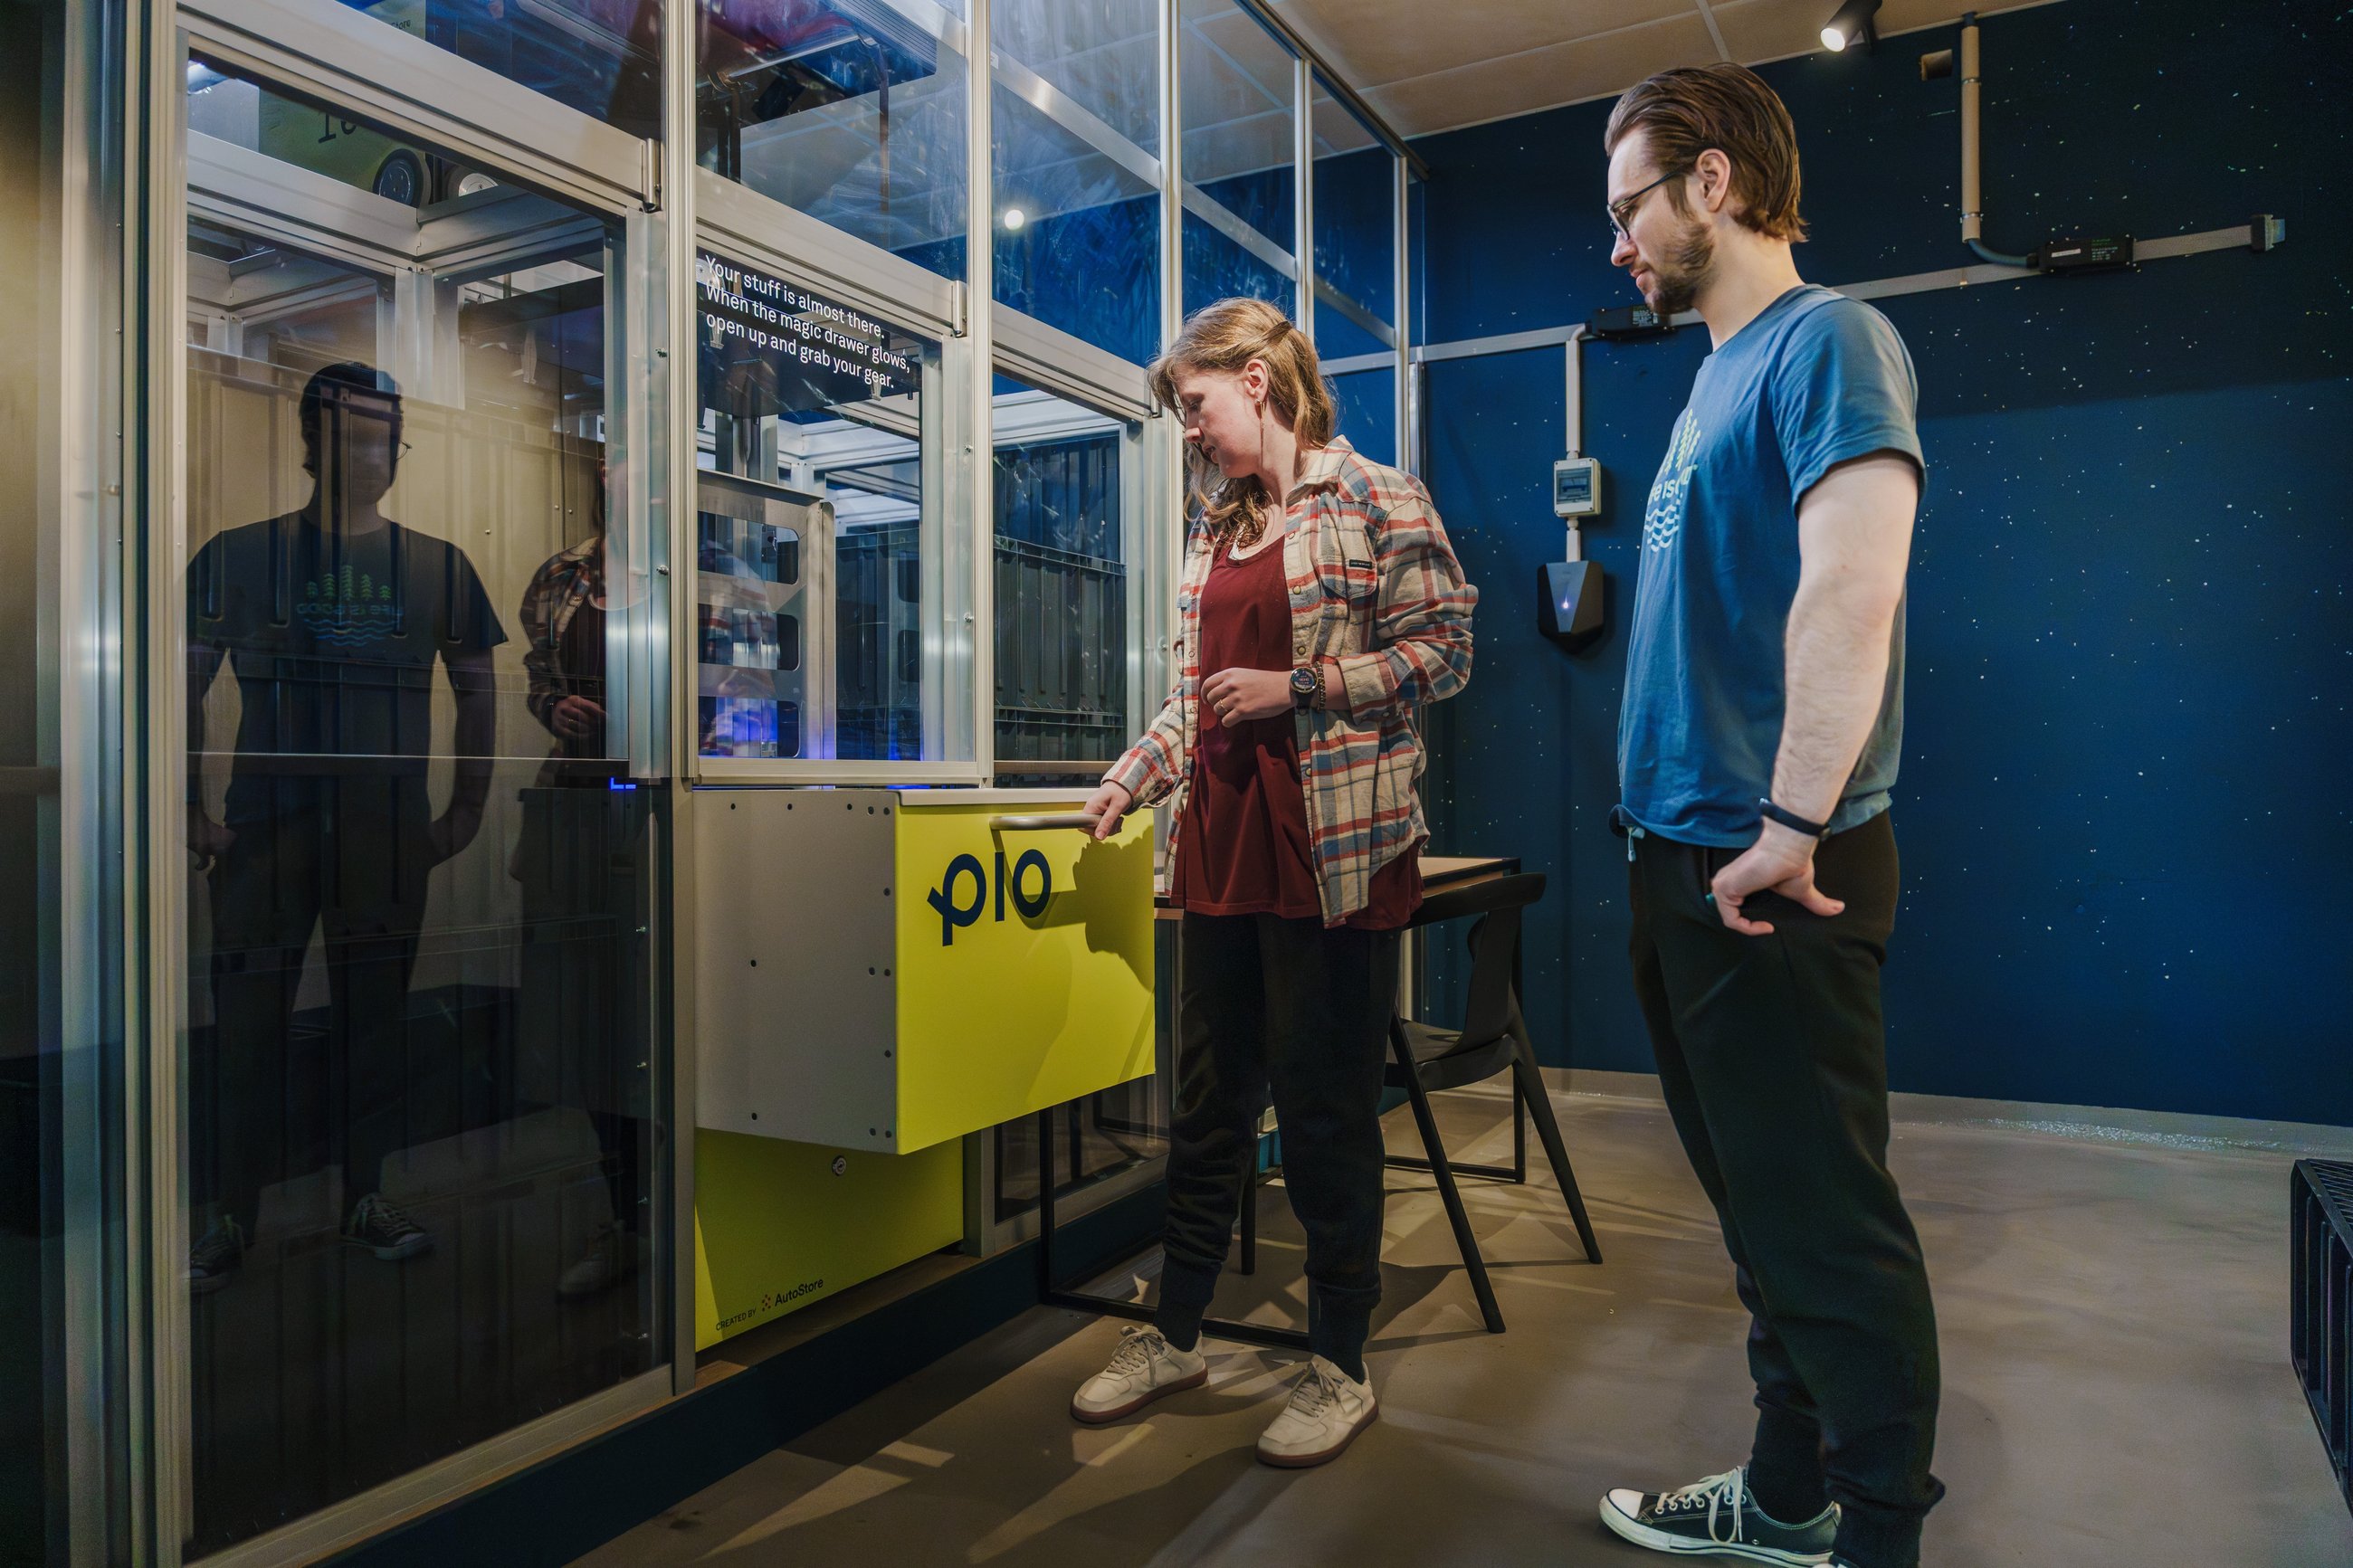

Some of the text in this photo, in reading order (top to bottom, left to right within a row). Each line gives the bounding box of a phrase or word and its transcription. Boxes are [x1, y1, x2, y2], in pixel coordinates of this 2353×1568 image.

[705, 254, 885, 339] Your stuff is almost there.
[706, 284, 910, 374] When the magic drawer glows,
[706, 314, 894, 389] open up and grab your gear.
[716, 1278, 824, 1331] CREATED BY AutoStore
